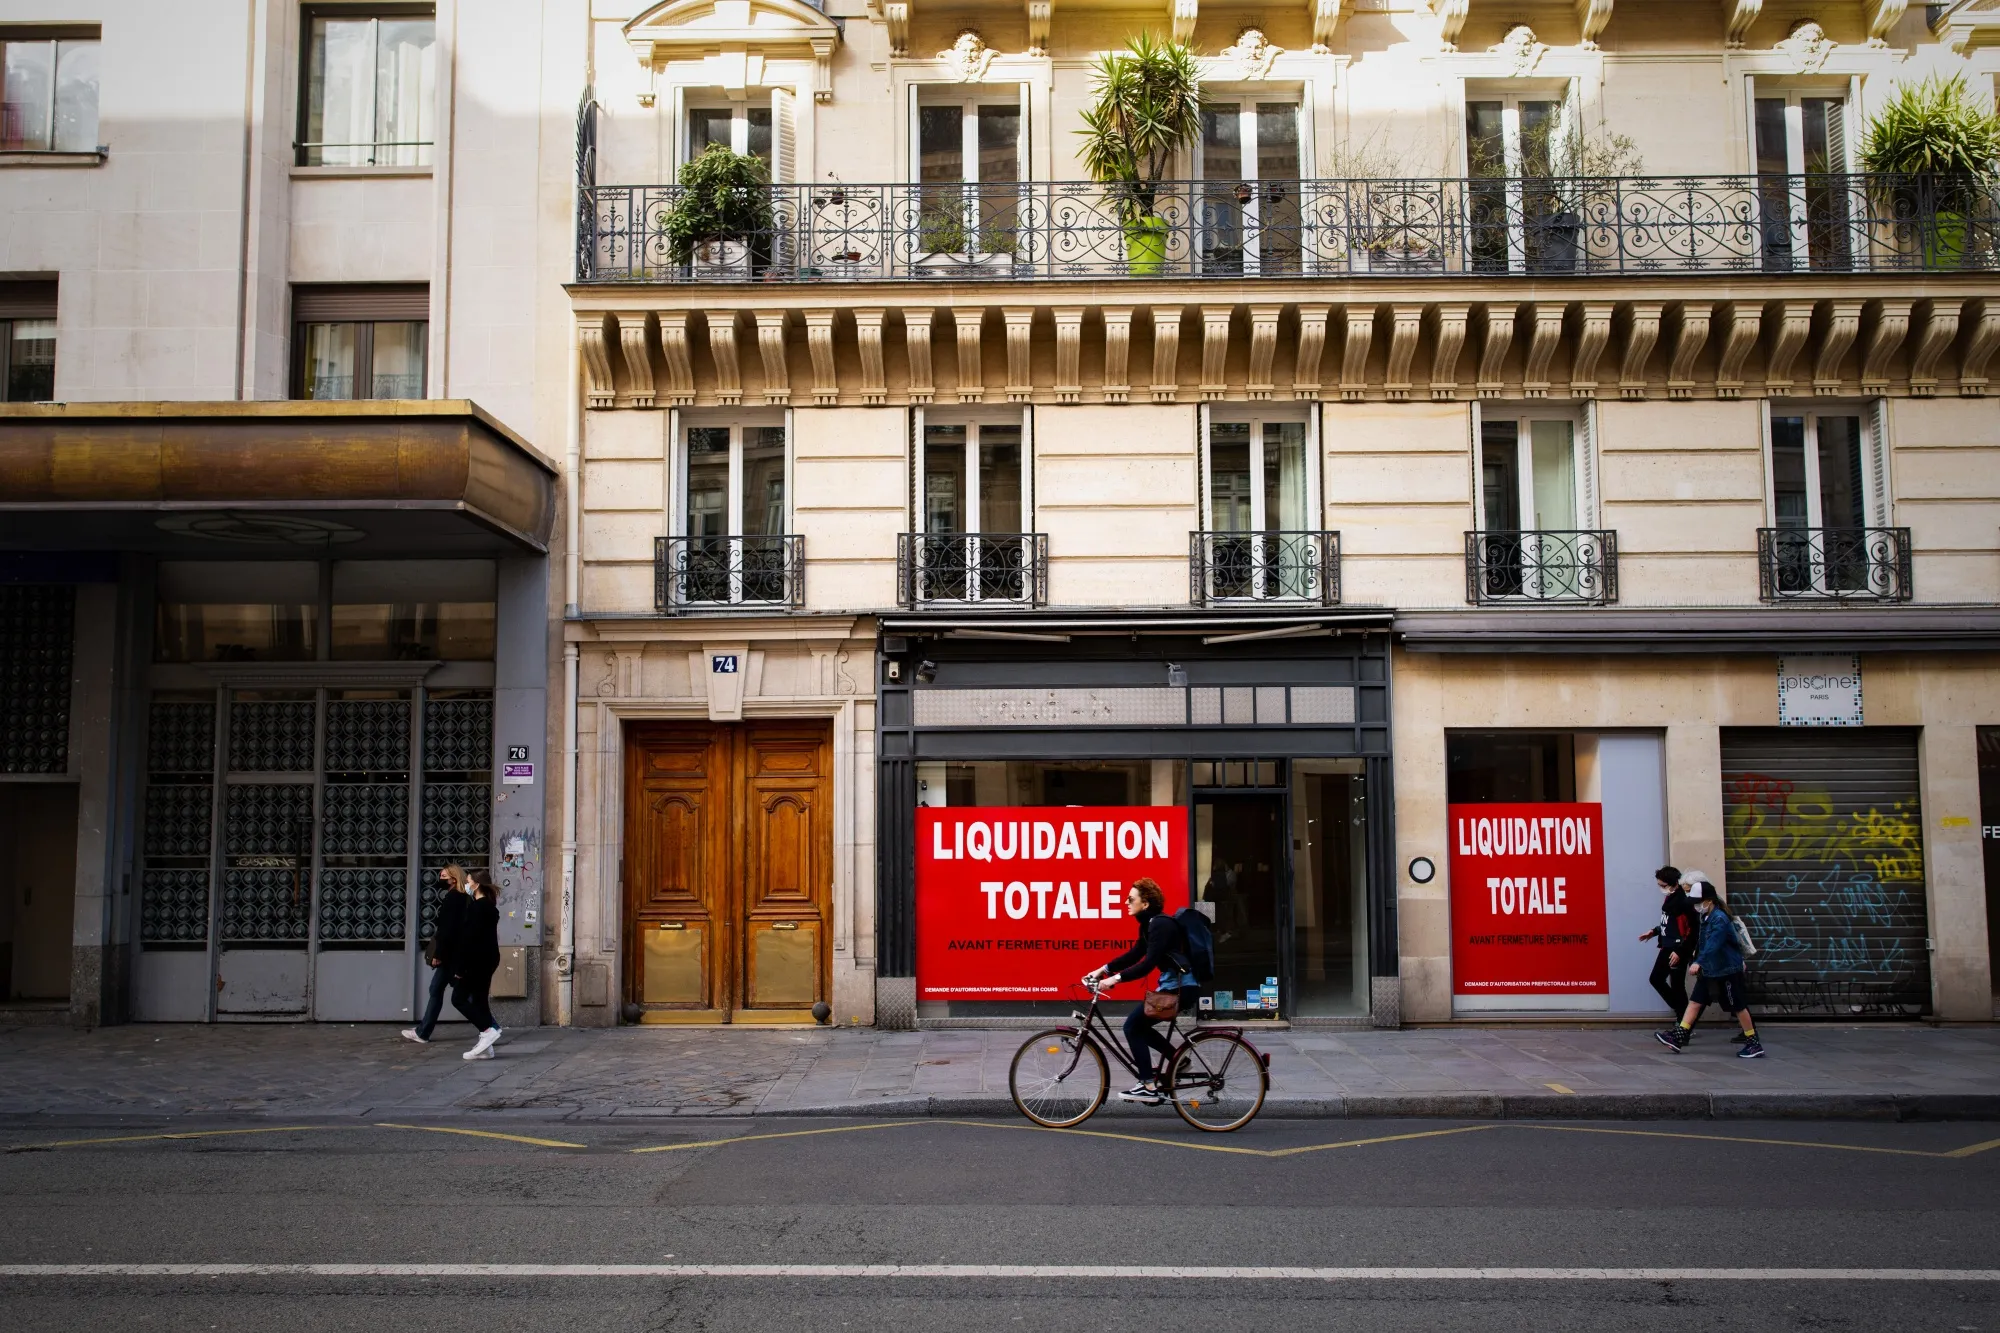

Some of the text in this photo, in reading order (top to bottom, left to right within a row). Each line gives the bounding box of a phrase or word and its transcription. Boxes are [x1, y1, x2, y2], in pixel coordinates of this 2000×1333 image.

[715, 657, 735, 672] 74
[510, 747, 526, 759] 76
[1458, 817, 1592, 858] LIQUIDATION
[1982, 826, 2000, 838] FE
[933, 821, 1169, 863] LIQUIDATION
[980, 881, 1122, 920] TOTALE
[1486, 877, 1568, 915] TOTALE
[948, 940, 1139, 950] AVANT FERMETURE DEFINIT
[1469, 934, 1589, 945] AVANT FERMETURE DEFINITIVE
